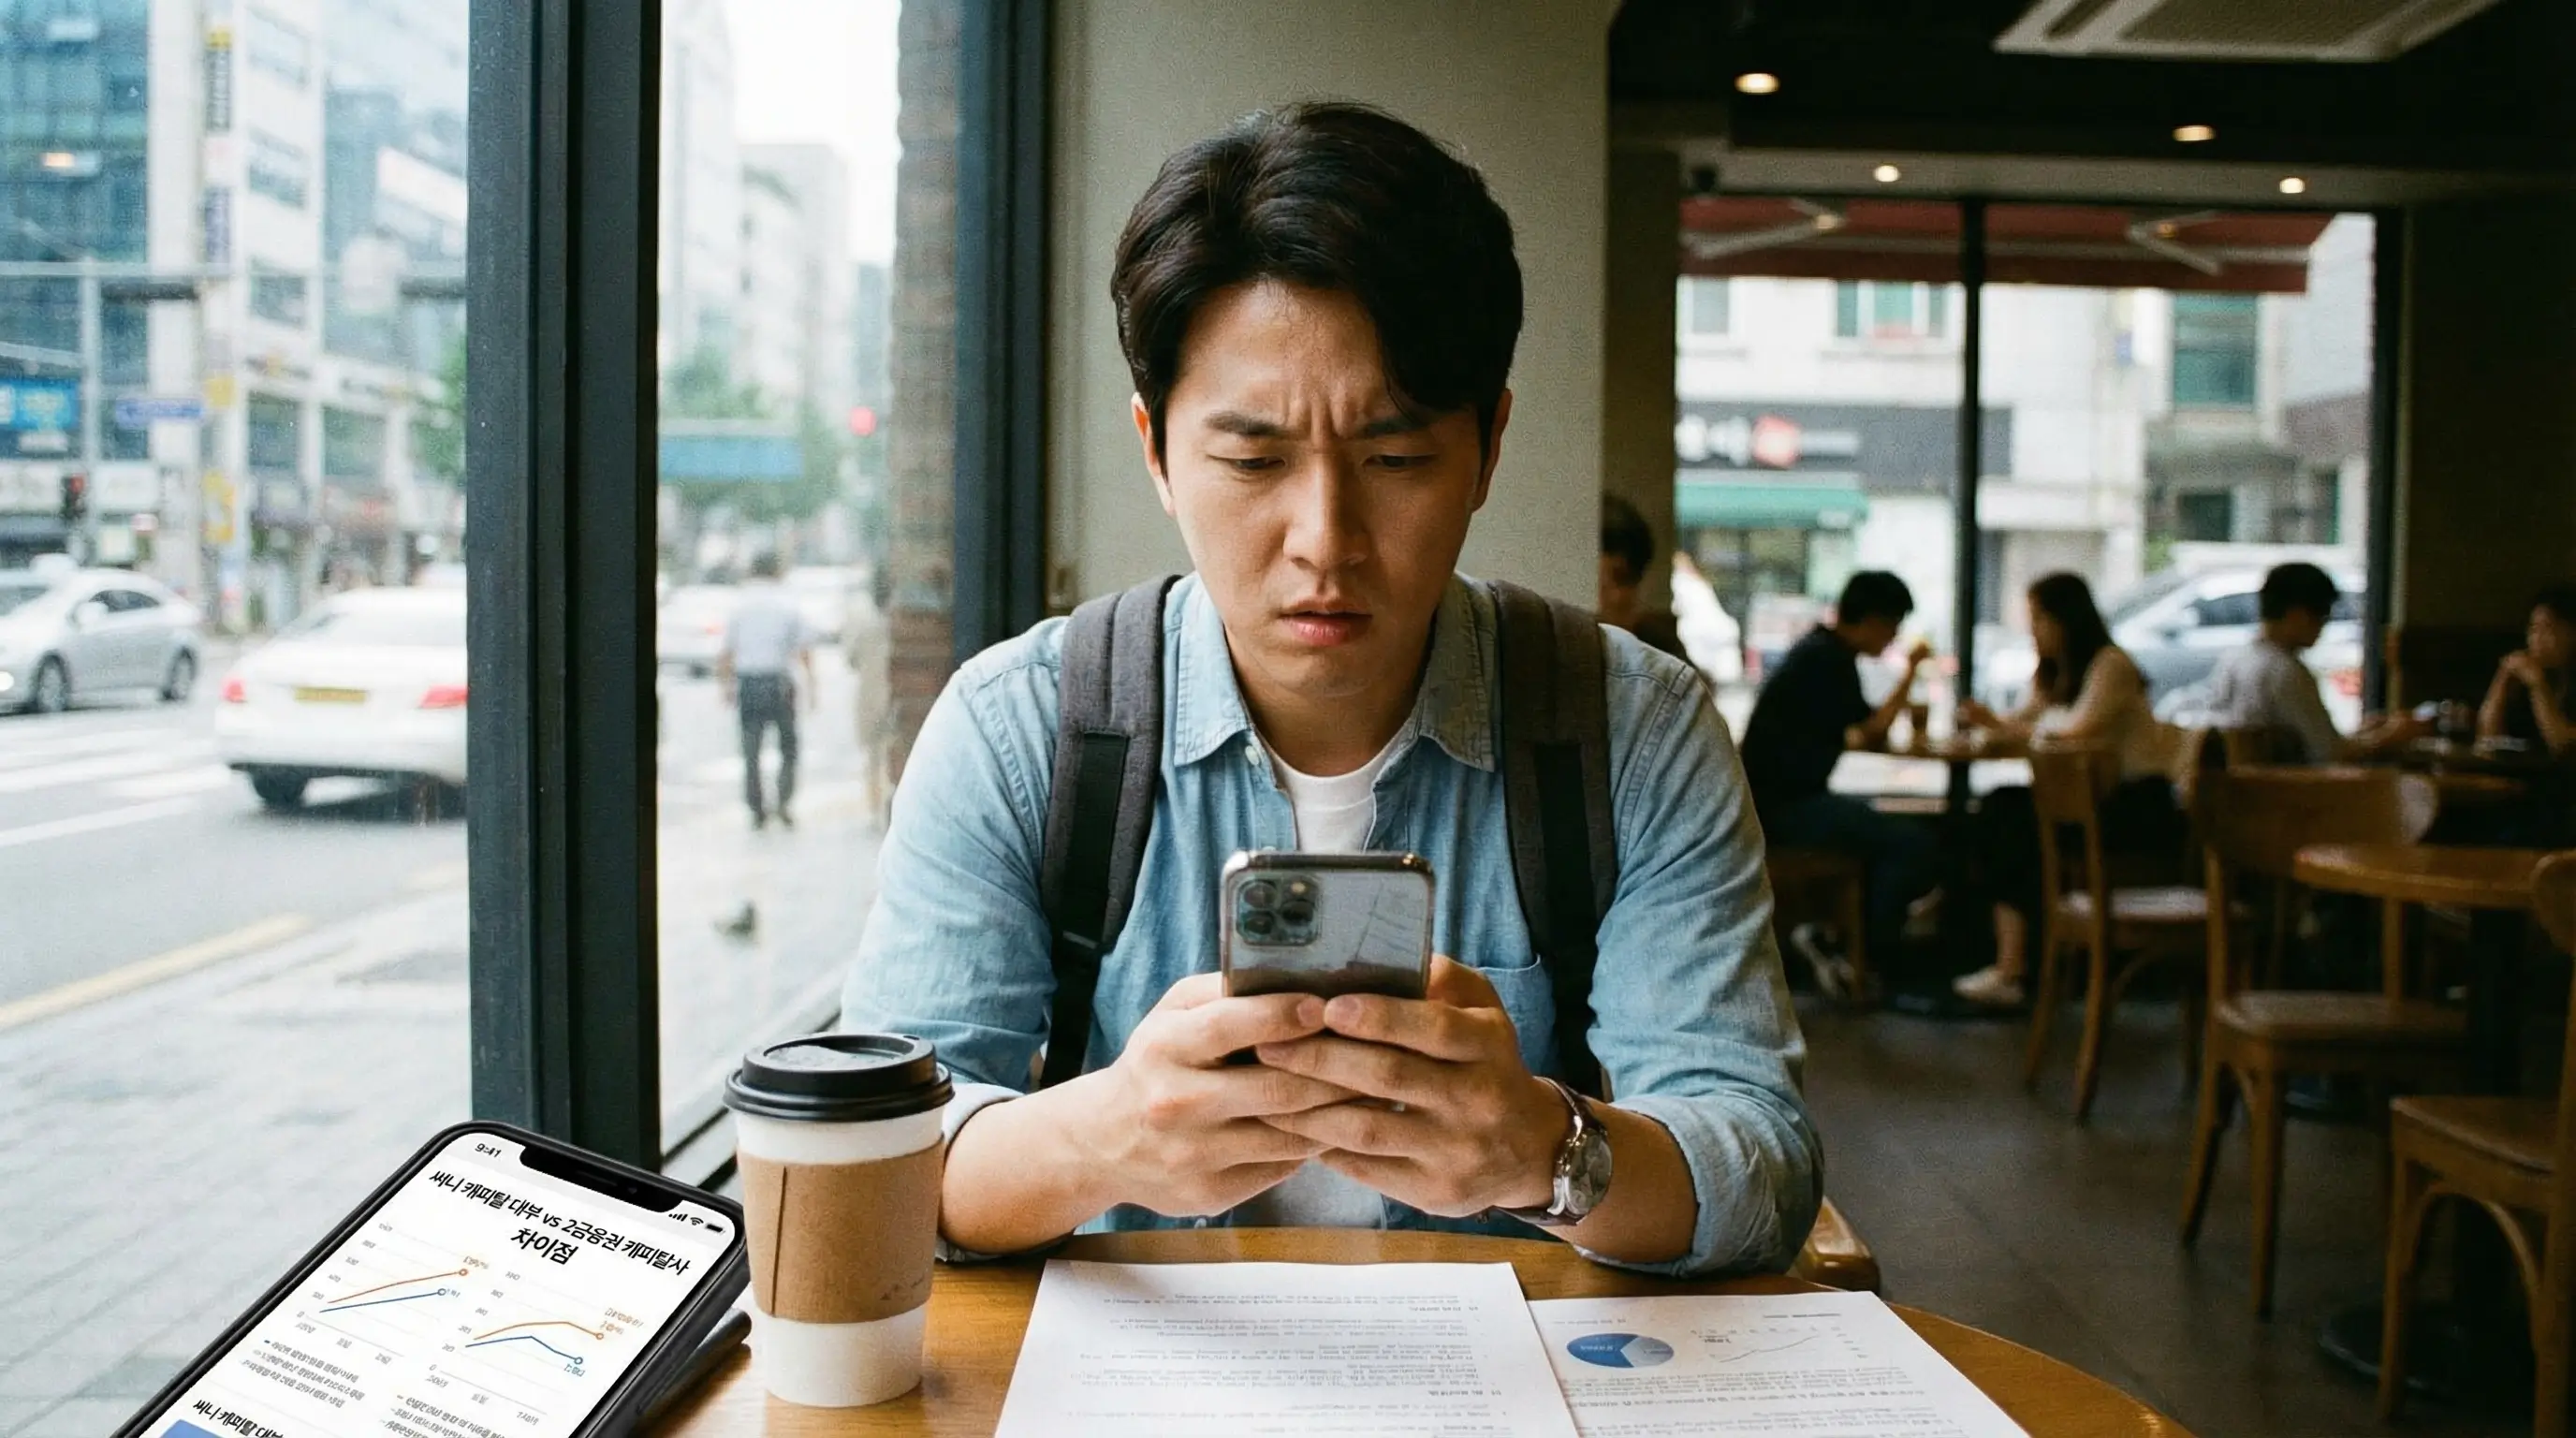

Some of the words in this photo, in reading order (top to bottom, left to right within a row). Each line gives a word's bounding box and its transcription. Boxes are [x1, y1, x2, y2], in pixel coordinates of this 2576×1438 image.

[475, 1143, 502, 1157] 9:41
[429, 1170, 465, 1193] 써니
[461, 1182, 511, 1210] 캐피탈
[507, 1199, 544, 1220] 대부
[542, 1213, 563, 1227] vs
[562, 1219, 625, 1251] 2금융권
[622, 1240, 691, 1275] 캐피탈사
[510, 1228, 578, 1265] 차이점
[193, 1400, 222, 1420] 써니
